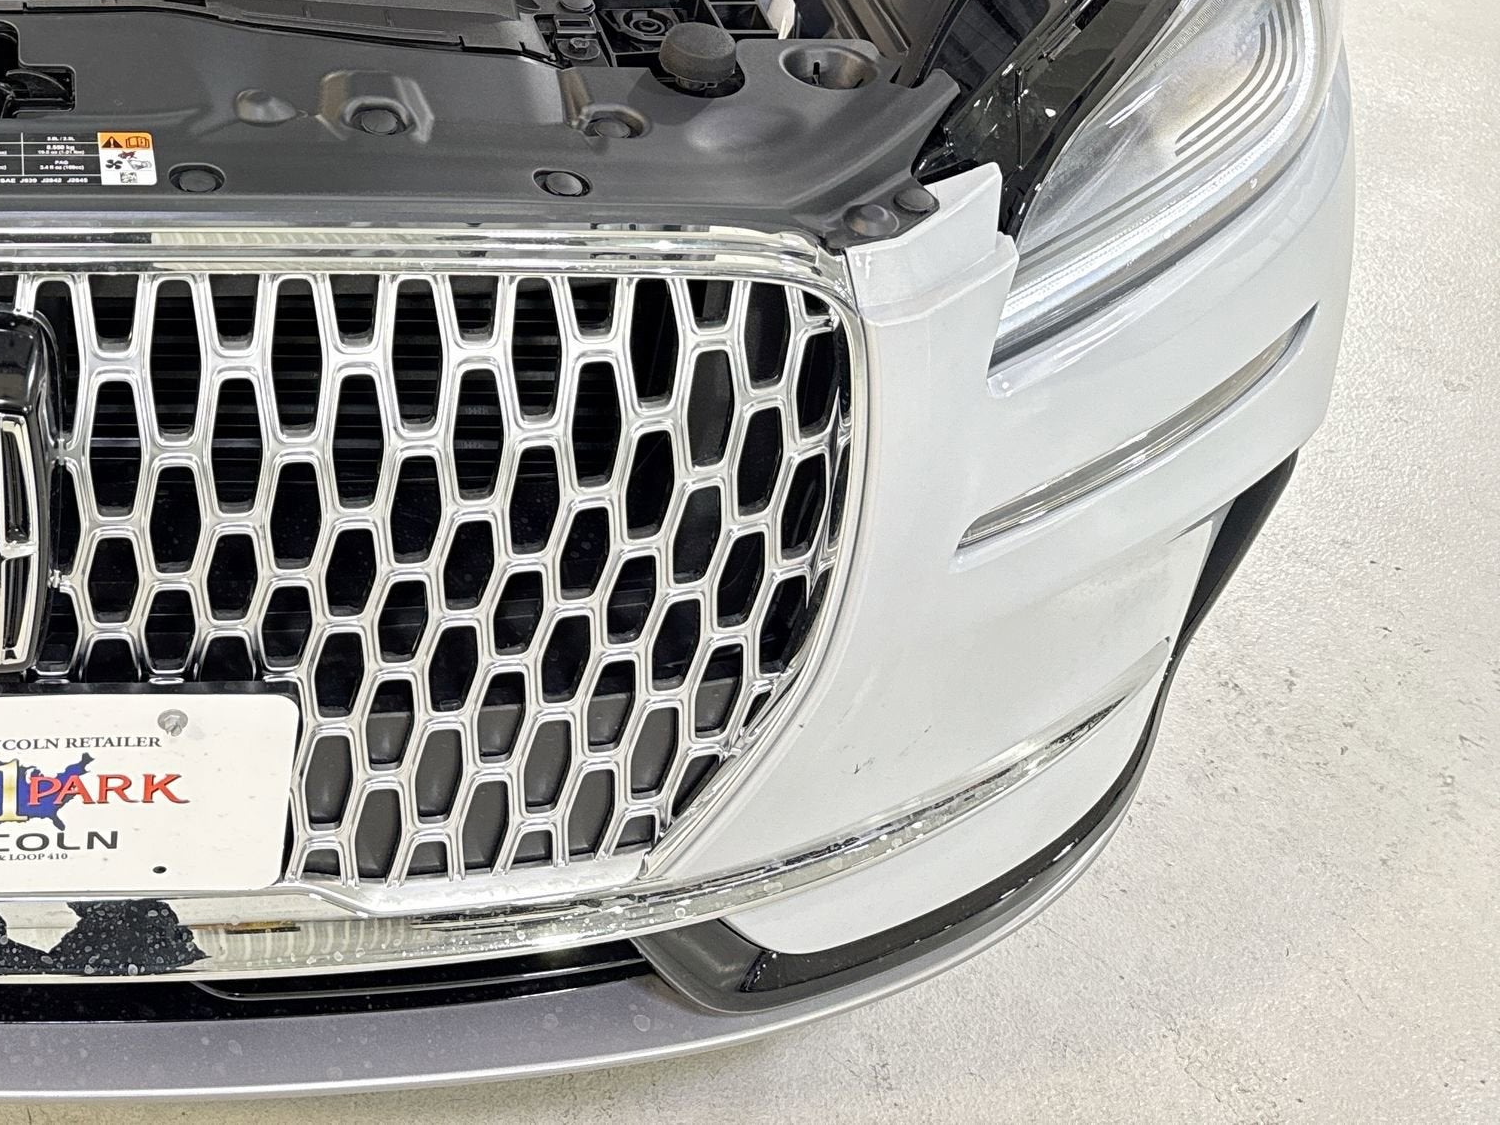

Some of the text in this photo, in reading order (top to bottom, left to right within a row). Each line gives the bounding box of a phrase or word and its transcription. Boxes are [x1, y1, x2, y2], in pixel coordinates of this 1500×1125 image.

[65, 736, 162, 749] RETAILER
[28, 774, 190, 805] PARK
[9, 853, 45, 861] LOOP
[47, 852, 68, 860] 410
